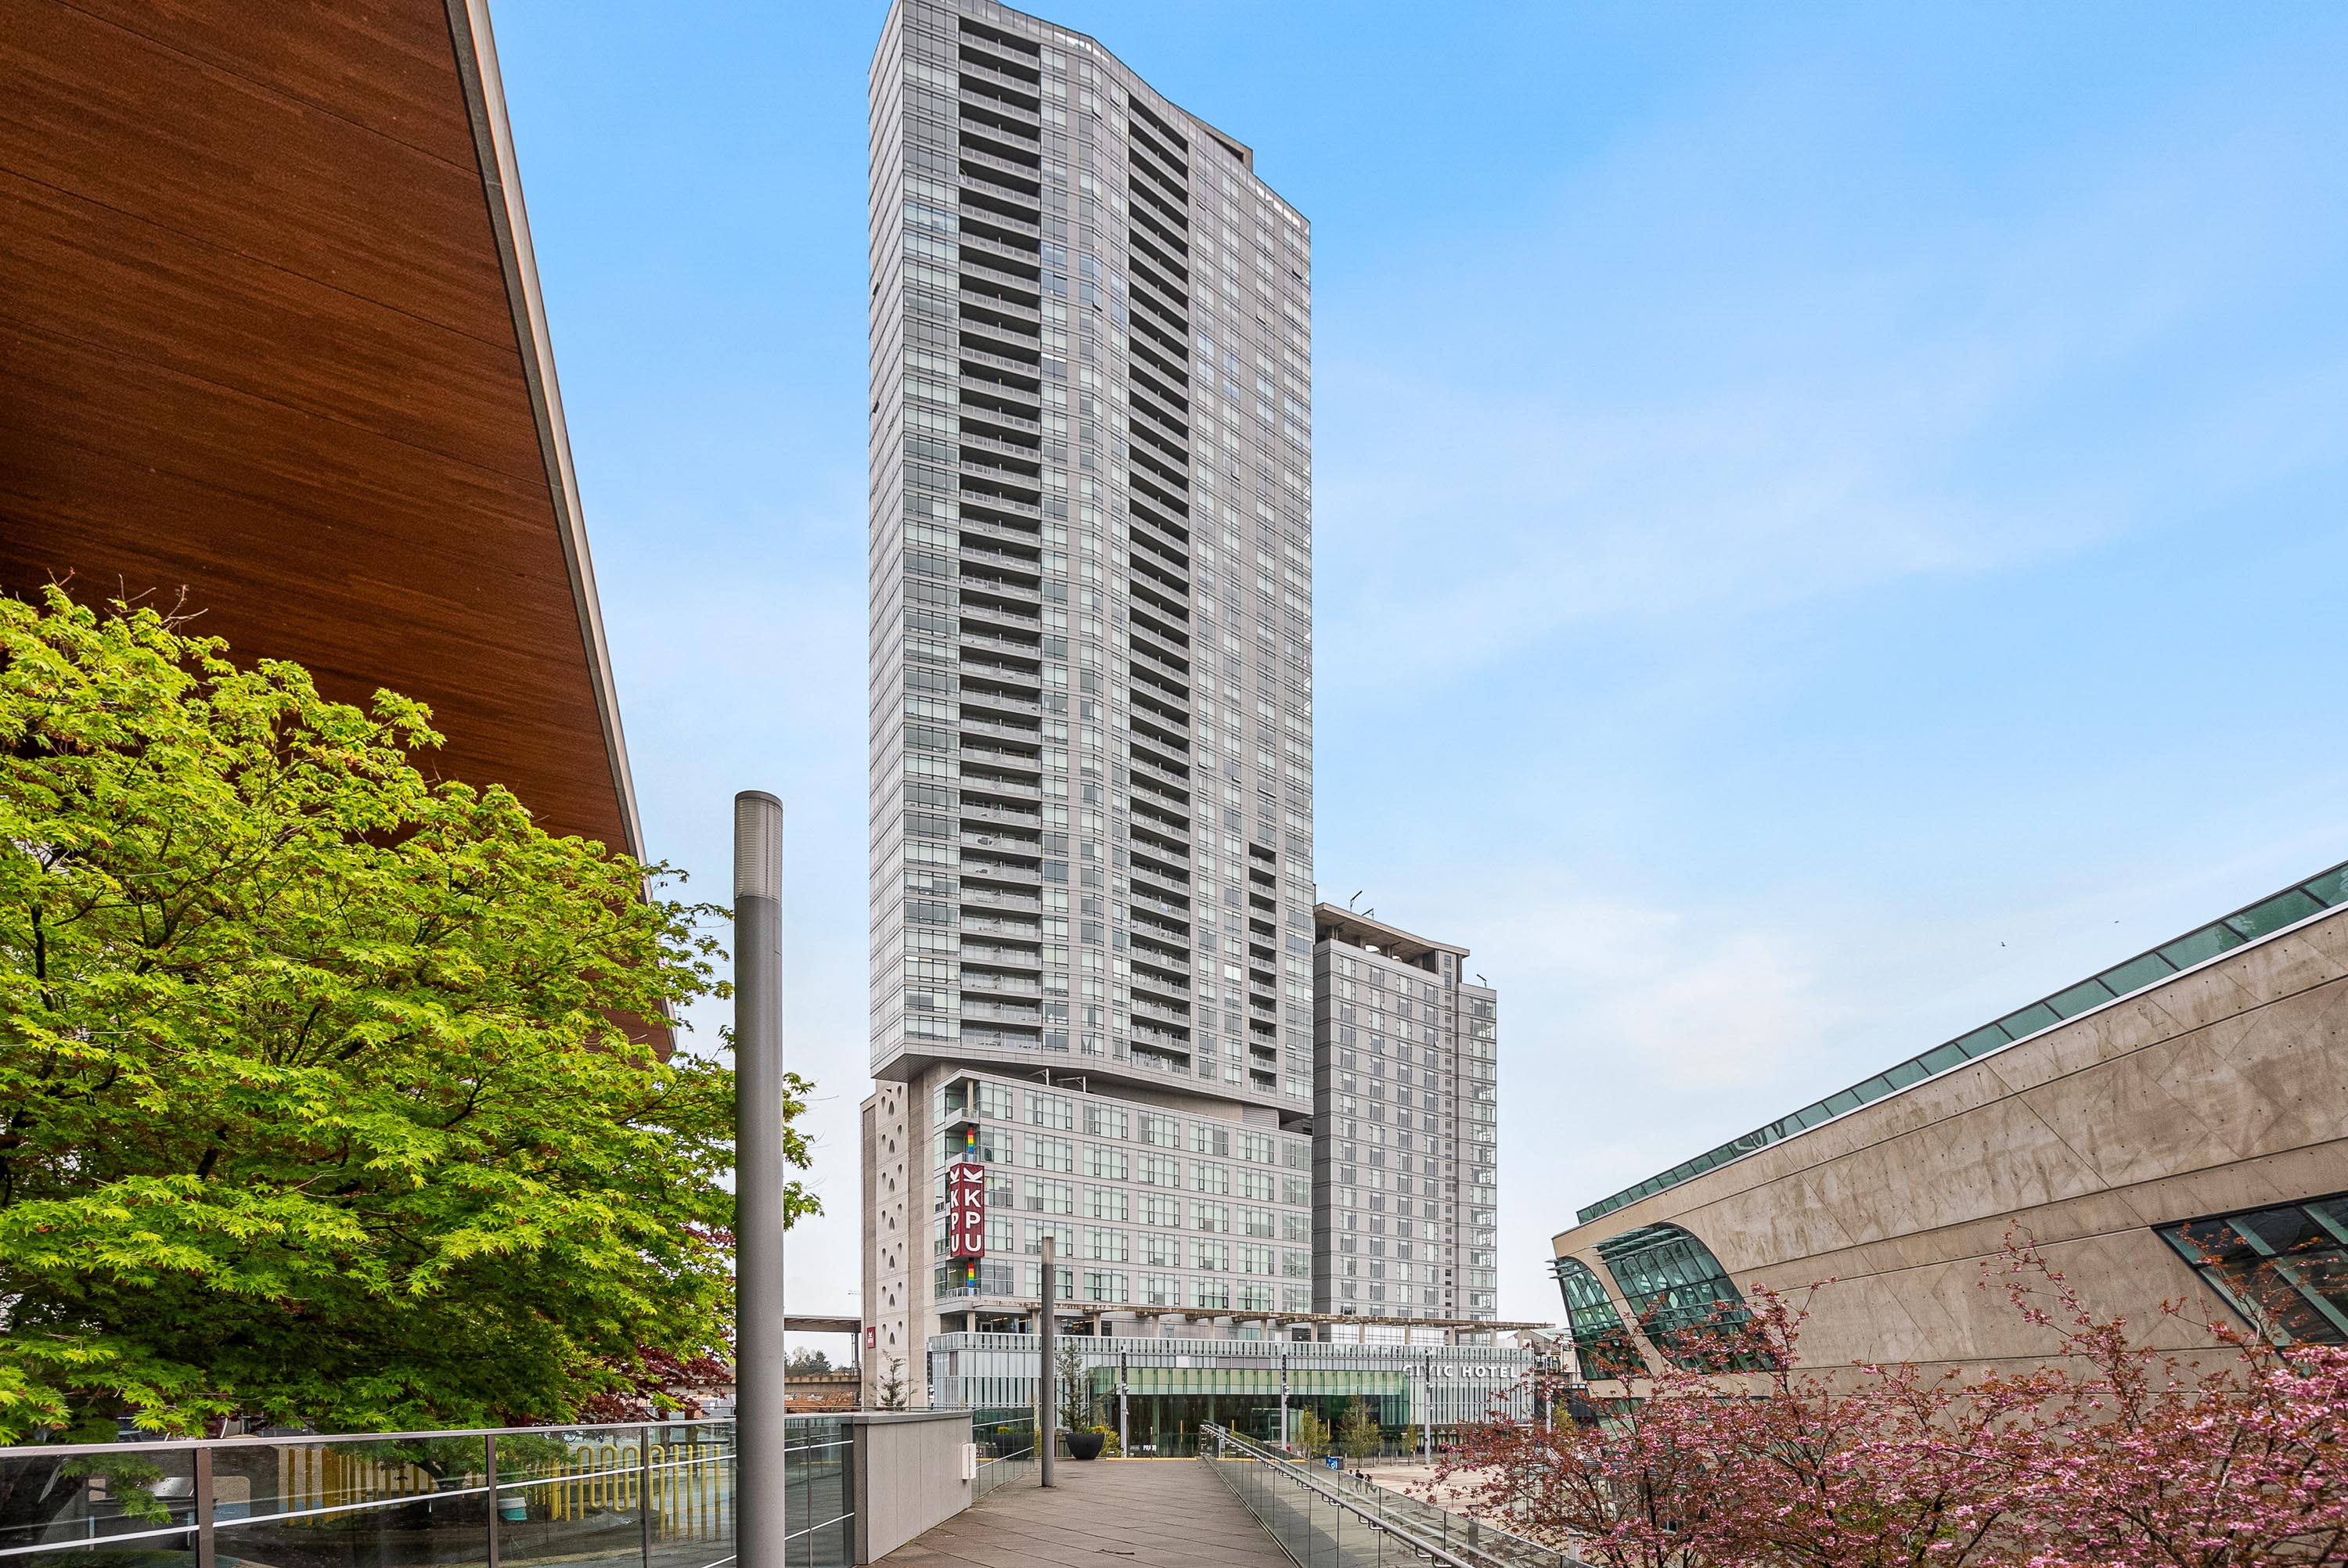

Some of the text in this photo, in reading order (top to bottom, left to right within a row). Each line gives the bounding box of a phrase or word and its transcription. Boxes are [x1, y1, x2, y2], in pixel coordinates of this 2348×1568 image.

[950, 1189, 960, 1253] KPU
[964, 1188, 981, 1252] KPU
[1462, 1365, 1518, 1378] HOTEL
